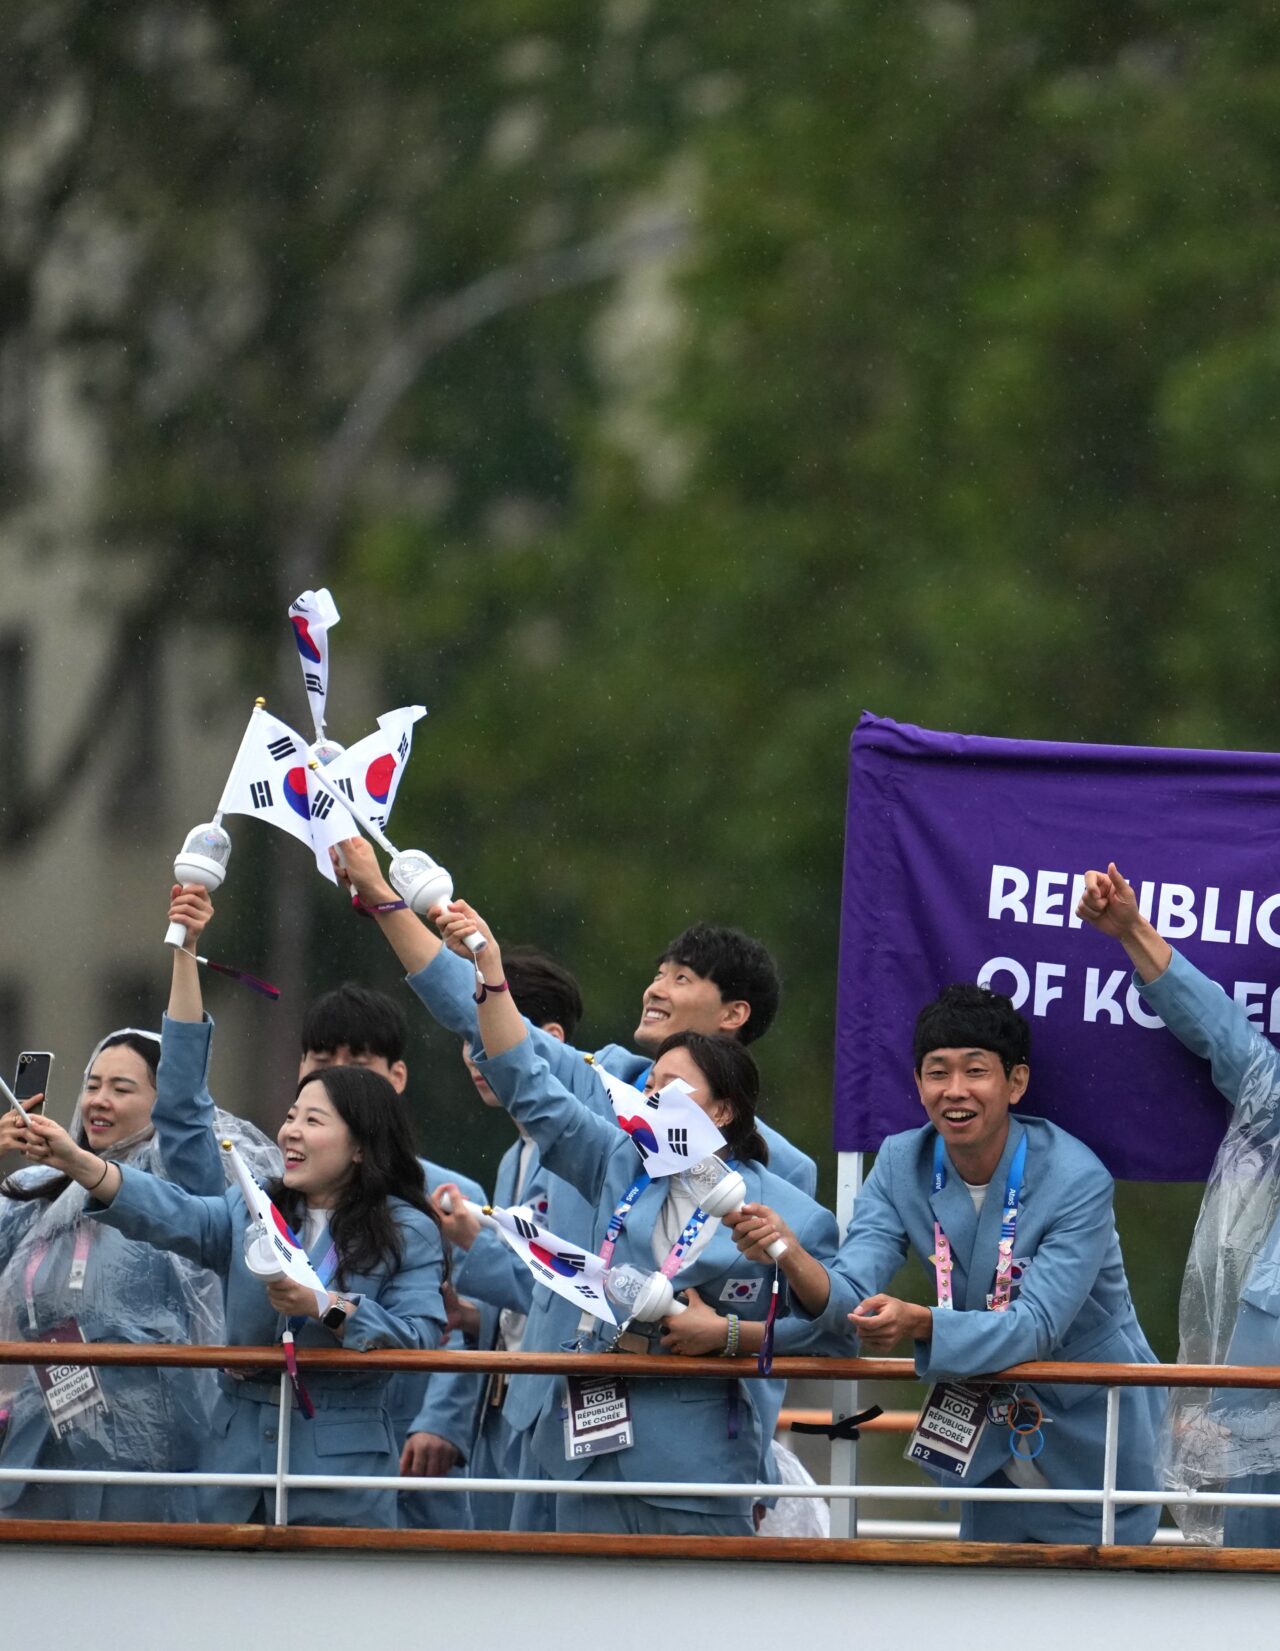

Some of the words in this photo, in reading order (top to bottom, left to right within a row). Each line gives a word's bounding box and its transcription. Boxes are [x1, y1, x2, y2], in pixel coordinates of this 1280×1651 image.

[977, 956, 1066, 1016] OF
[586, 1391, 614, 1405] KOR
[577, 1401, 625, 1420] RÉPUBLIQUE
[582, 1419, 592, 1427] DE
[593, 1411, 621, 1424] CORÉE
[943, 1400, 971, 1419] KOR
[928, 1409, 973, 1436] RÉPUBLIQUE
[618, 1434, 626, 1444] R
[928, 1421, 938, 1432] DE
[938, 1426, 965, 1444] CORÉE
[955, 1463, 964, 1473] R
